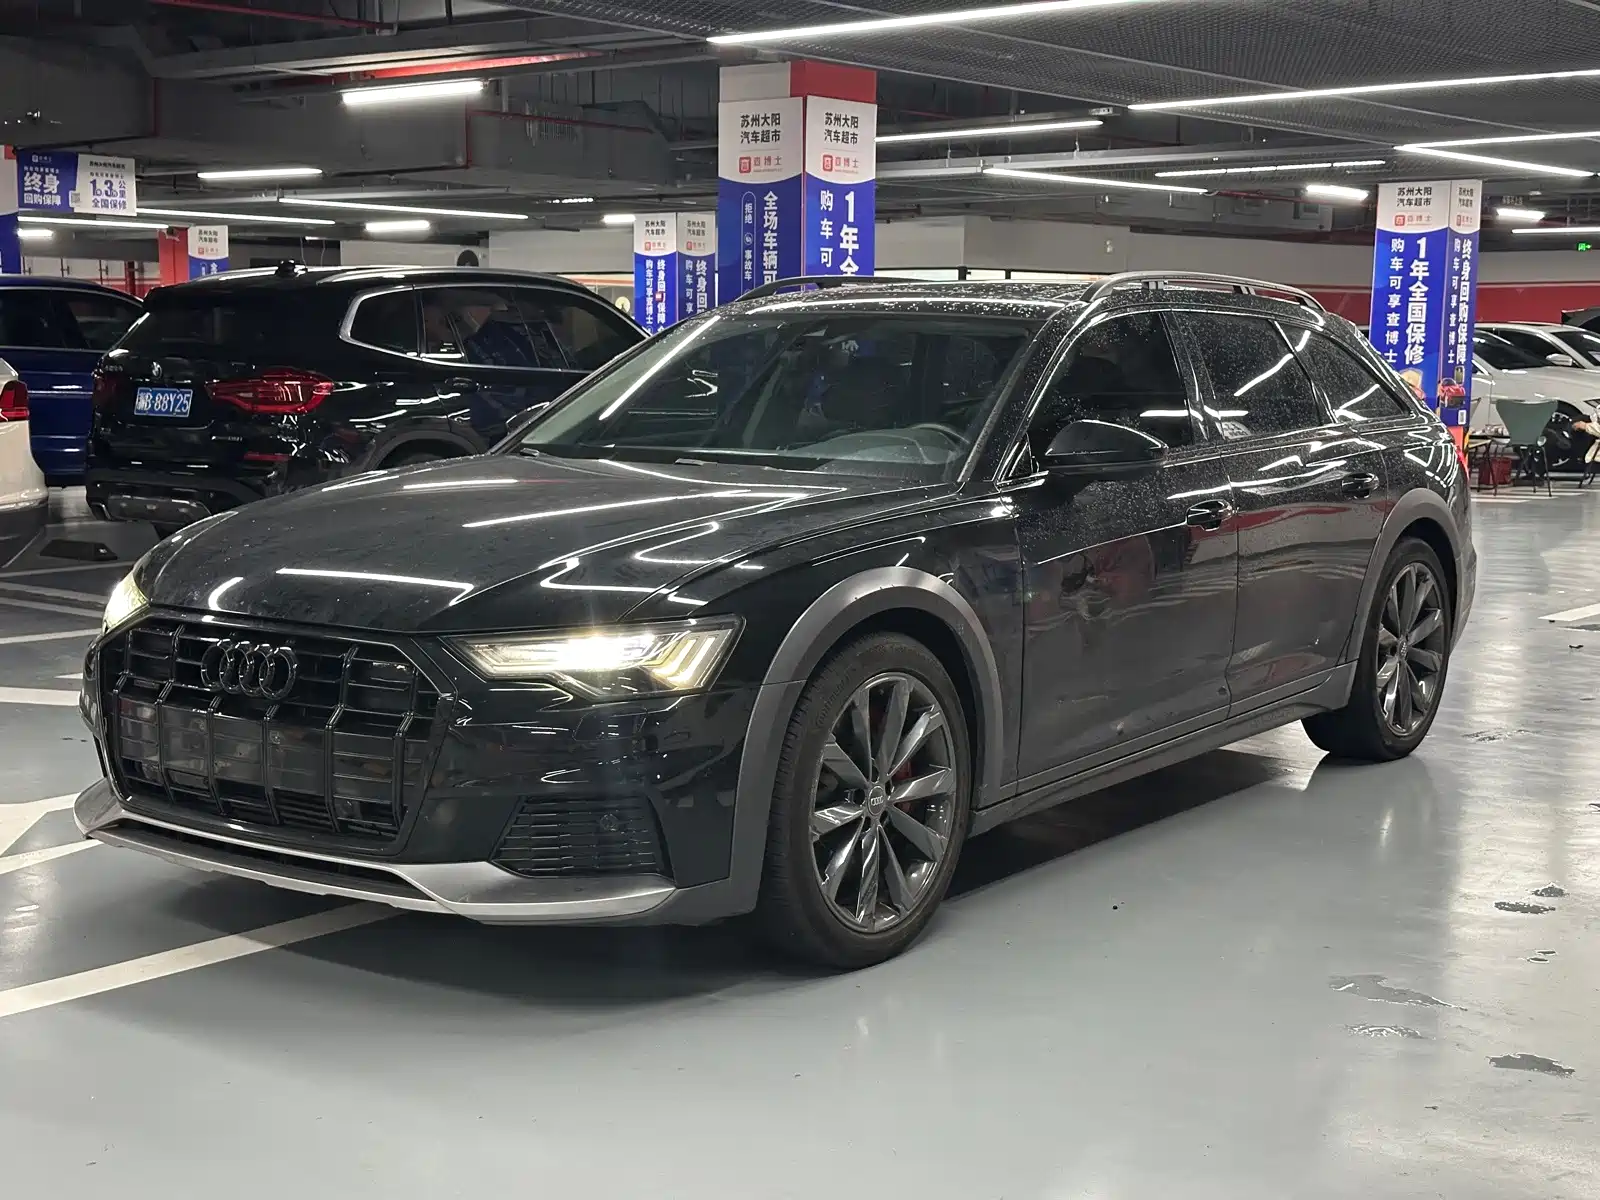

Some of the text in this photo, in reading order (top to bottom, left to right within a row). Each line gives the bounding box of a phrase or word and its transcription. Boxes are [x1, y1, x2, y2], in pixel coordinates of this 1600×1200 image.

[740, 113, 781, 128] 苏州大阳
[825, 112, 859, 128] 苏州大阳
[740, 129, 781, 144] 汽车超市
[824, 129, 858, 144] 汽车超市
[24, 172, 60, 193] 终身
[1397, 186, 1432, 196] 苏州大阳
[24, 193, 61, 206] 回购保障
[92, 199, 127, 210] 全国保修
[1397, 198, 1432, 207] 汽车超市
[820, 190, 834, 268] 购车可
[744, 203, 753, 281] 拒绝 事故车
[1384, 238, 1405, 363] 购车可享查博士
[1404, 236, 1430, 365] 1年全国保修
[1448, 238, 1460, 364] 购车可享查博士
[1456, 238, 1472, 365] 终身回购保障
